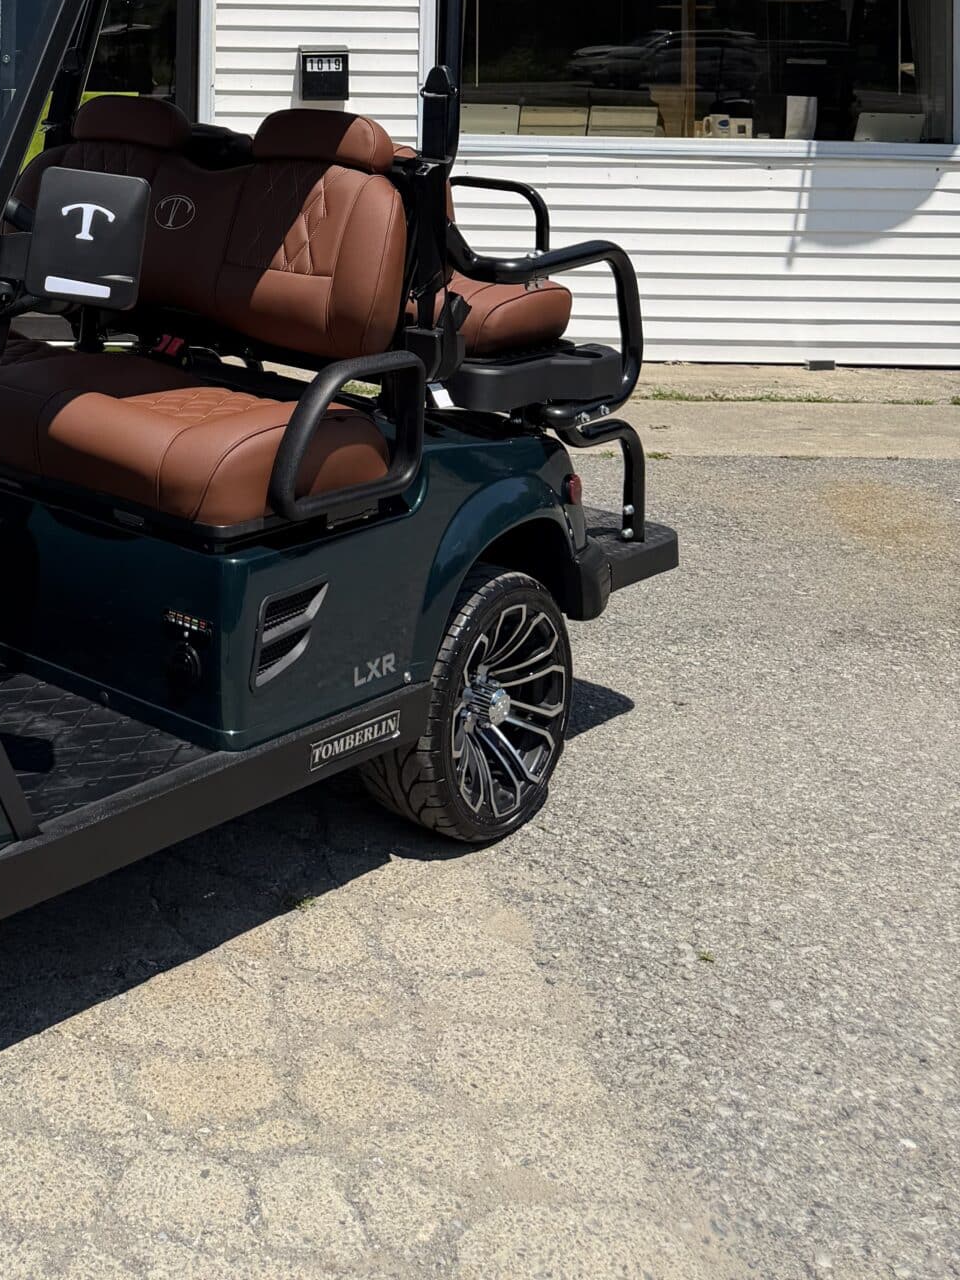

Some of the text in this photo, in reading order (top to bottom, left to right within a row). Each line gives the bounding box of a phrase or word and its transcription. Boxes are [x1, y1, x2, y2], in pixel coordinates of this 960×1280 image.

[309, 58, 341, 70] 1019
[61, 203, 115, 240] T
[353, 652, 397, 687] LXR
[311, 716, 397, 763] TOMBERLIN
